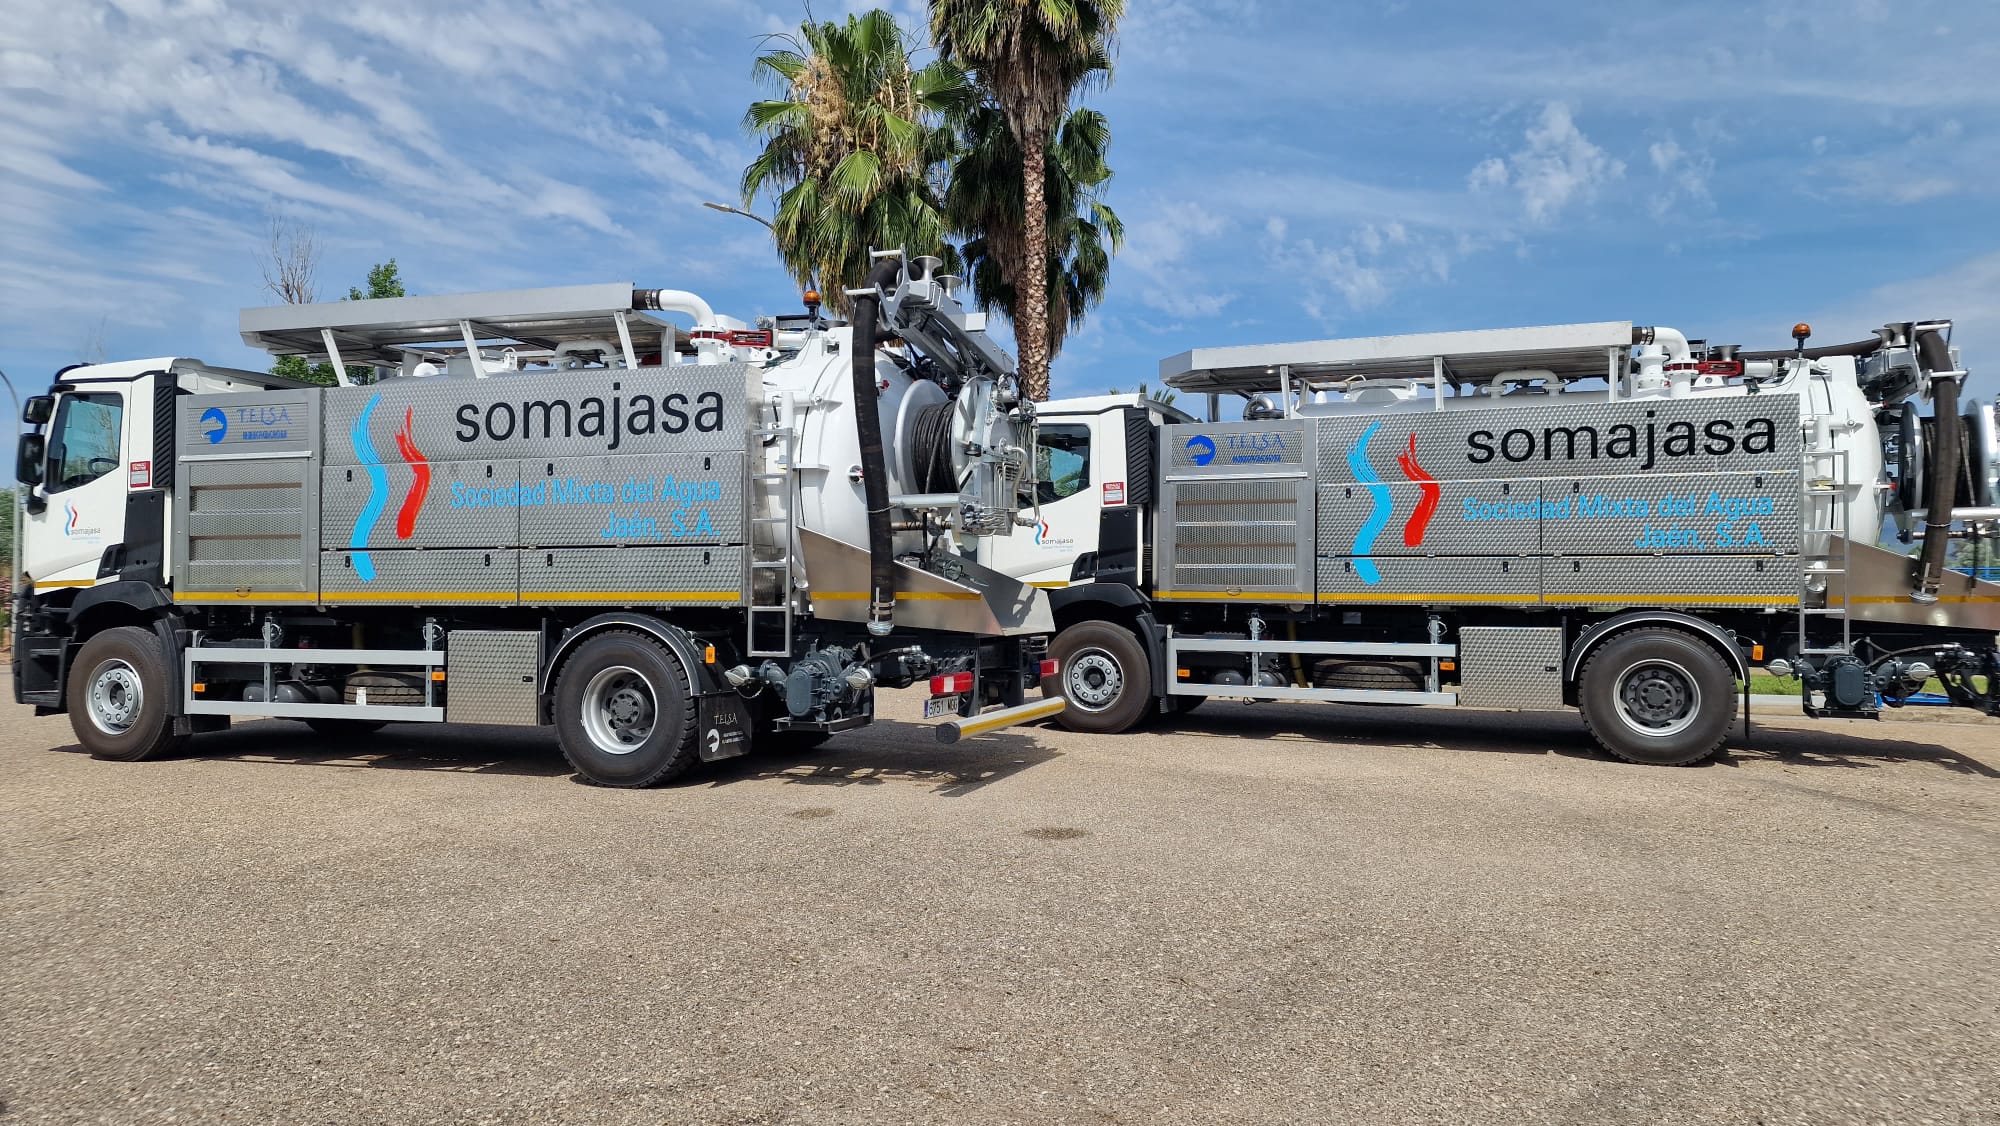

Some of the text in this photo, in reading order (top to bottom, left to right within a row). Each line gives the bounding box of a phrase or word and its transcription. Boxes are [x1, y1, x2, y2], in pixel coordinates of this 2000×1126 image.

[237, 406, 293, 425] TELSA
[456, 382, 723, 450] somajasa
[1226, 433, 1286, 451] TELSA
[1467, 410, 1776, 470] somajasa
[451, 474, 721, 508] Sociedad Mixta del Agua
[1463, 492, 1774, 521] Sociedad Mixta del Agua
[601, 508, 721, 541] Jaén, S.A.
[1635, 522, 1773, 549] Jaén, S.A.
[713, 712, 738, 725] TELSA
